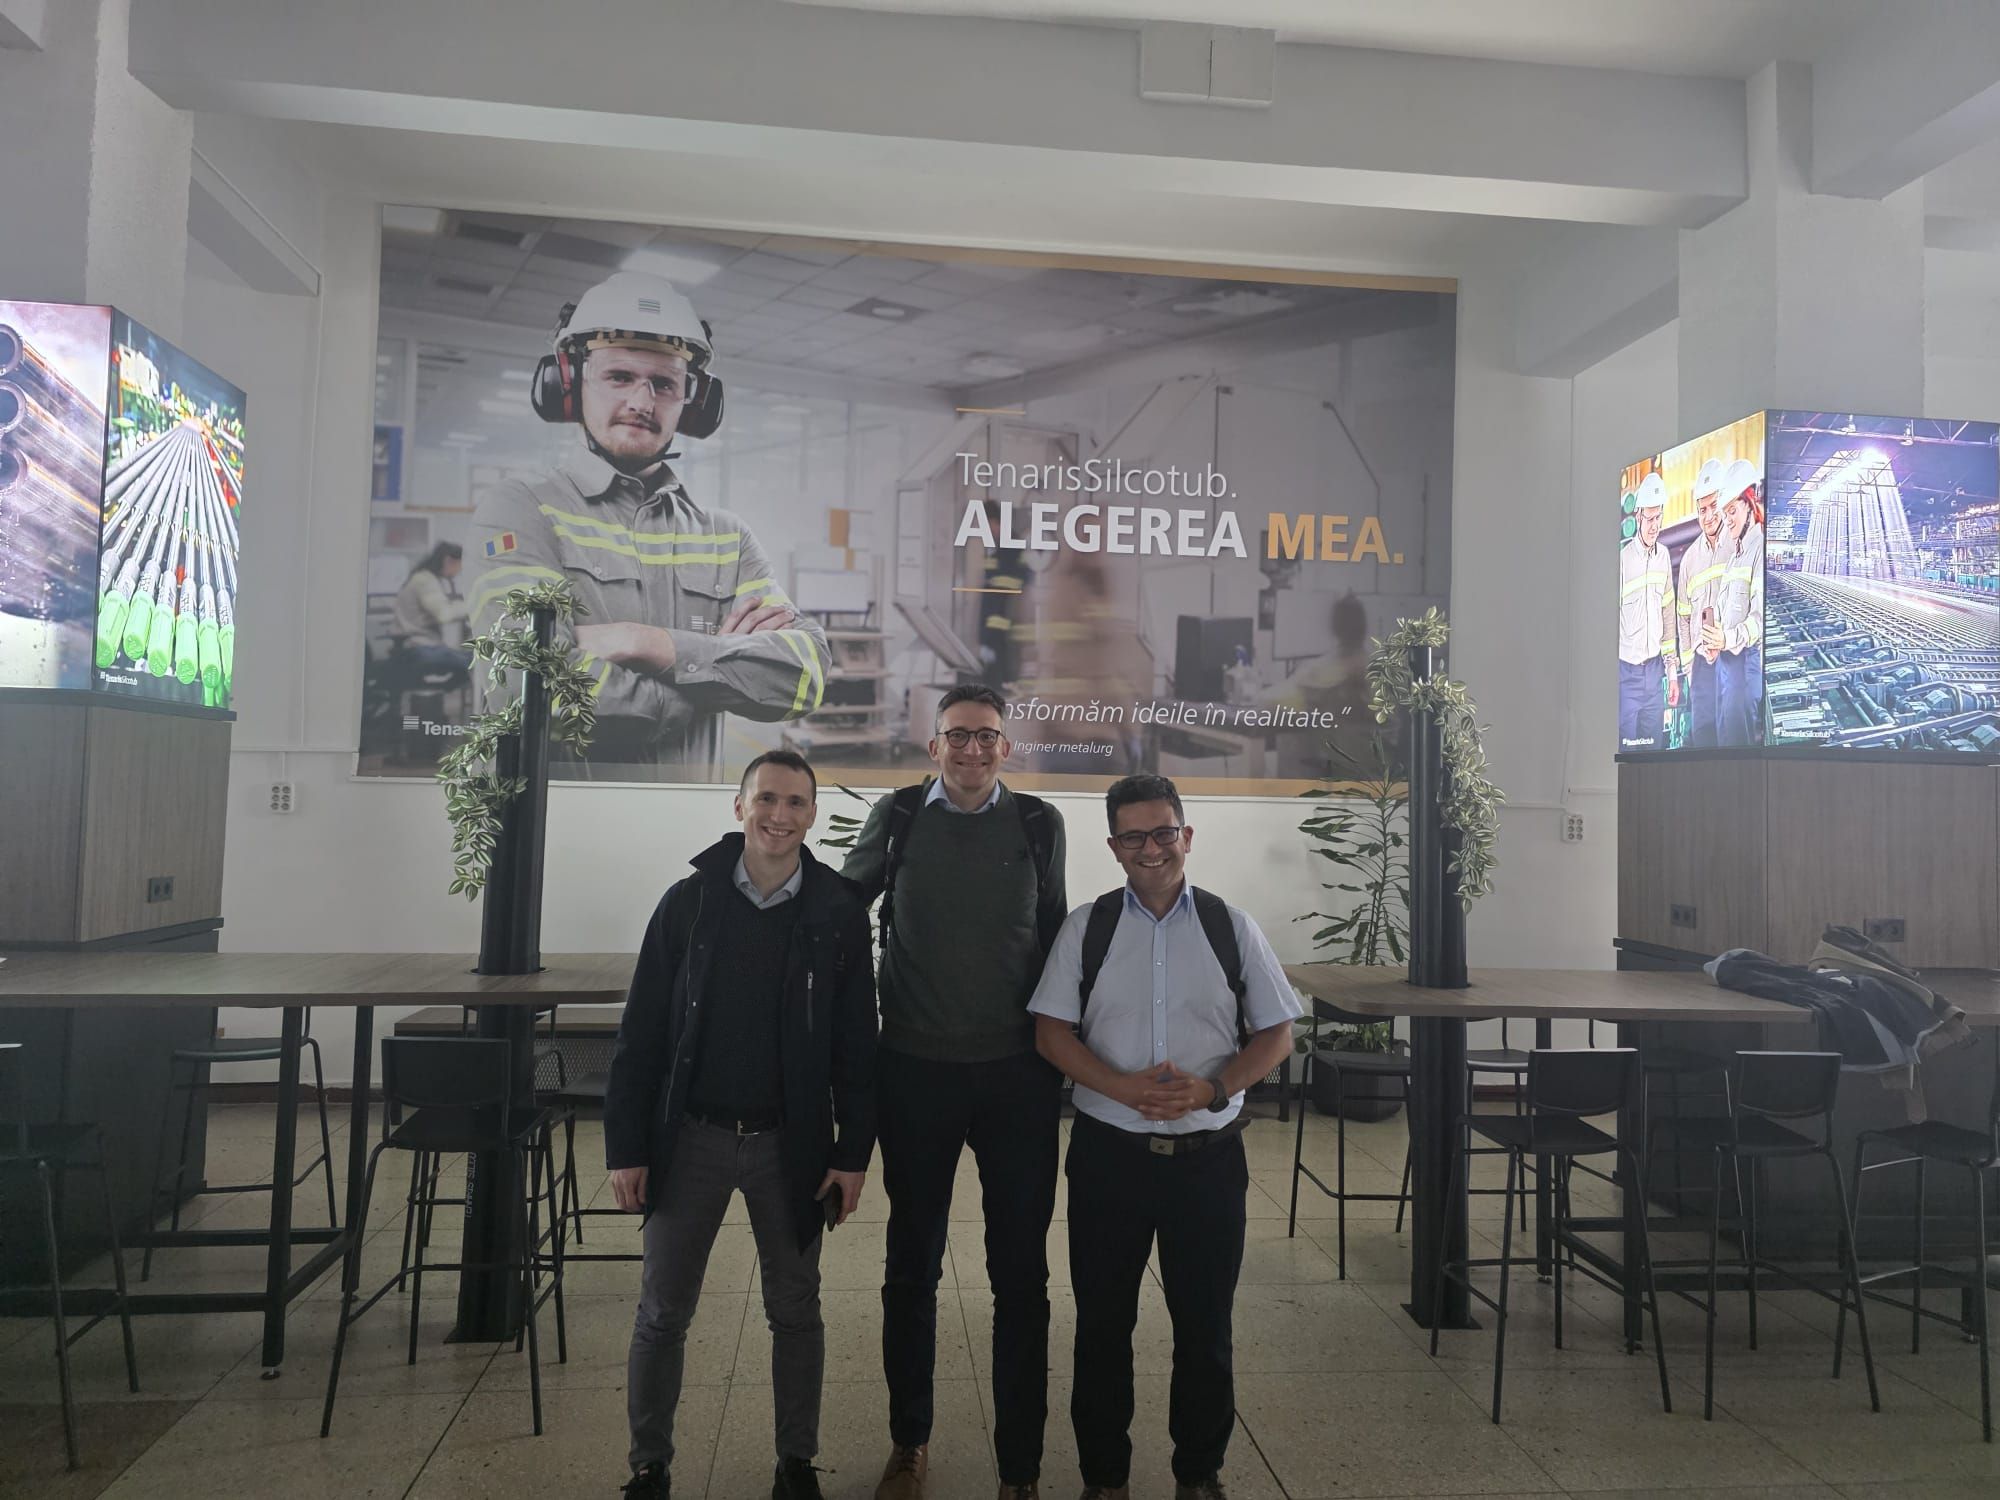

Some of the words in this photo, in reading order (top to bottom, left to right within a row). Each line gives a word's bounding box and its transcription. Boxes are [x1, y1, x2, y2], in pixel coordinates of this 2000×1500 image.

[955, 452, 1238, 498] TenarisSilcotub.
[953, 500, 1247, 558] ALEGEREA
[1267, 512, 1405, 564] MEA.
[1005, 697, 1124, 723] nsformăm
[1131, 701, 1197, 725] ideile
[1204, 702, 1226, 726] în
[1013, 740, 1056, 754] Inginer
[1058, 741, 1114, 757] metalurg
